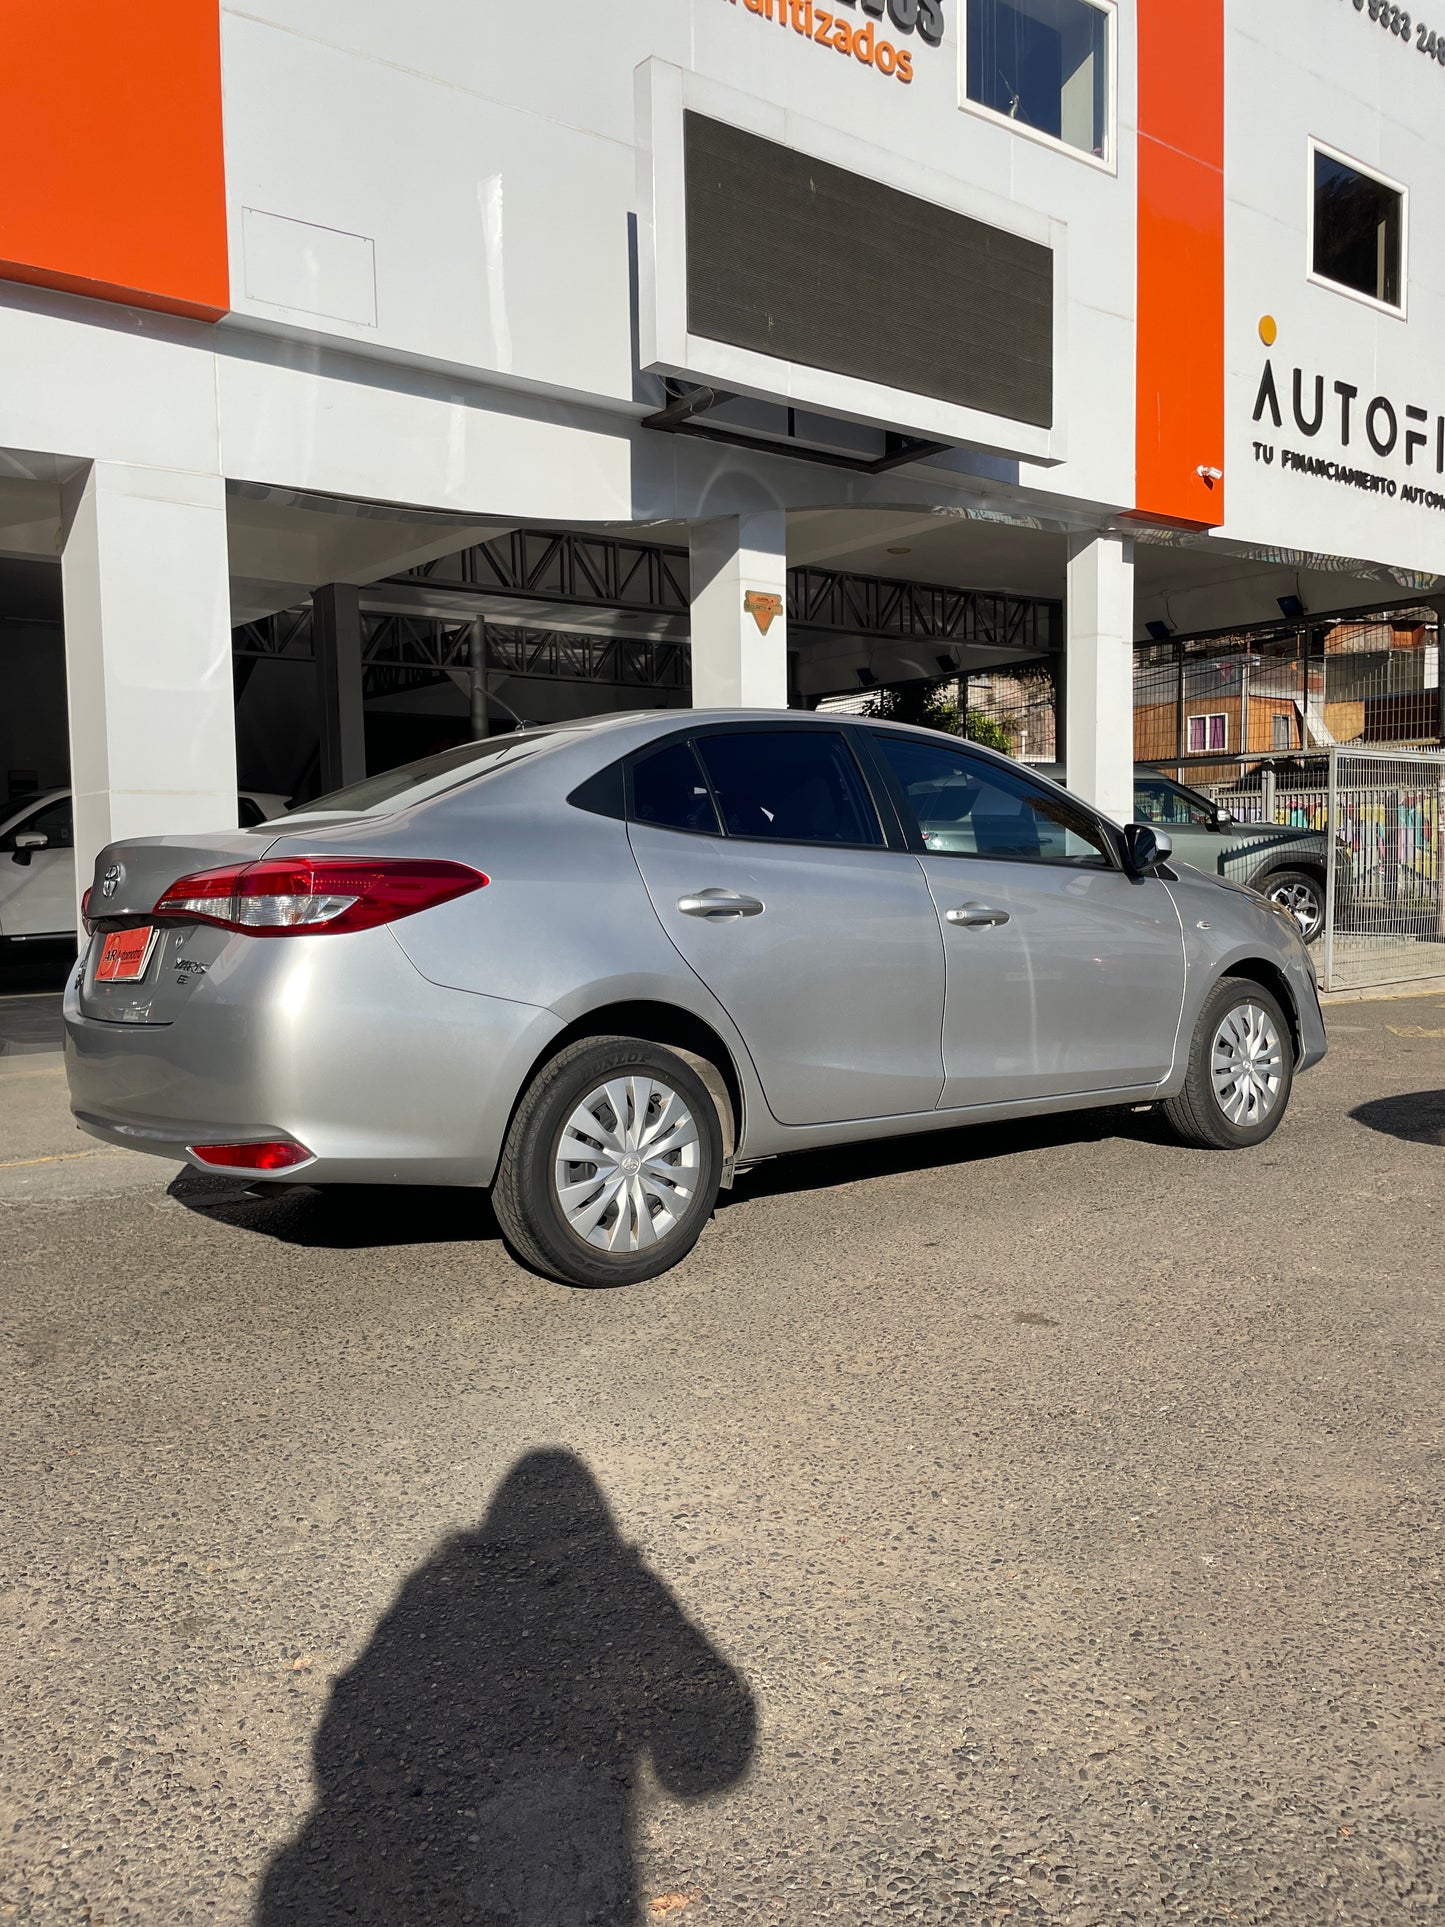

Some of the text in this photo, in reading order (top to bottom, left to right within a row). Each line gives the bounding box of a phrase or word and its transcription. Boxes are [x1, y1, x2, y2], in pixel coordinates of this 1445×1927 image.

[1252, 441, 1274, 465] TU
[1400, 484, 1445, 511] AUTOM
[106, 949, 118, 961] AR
[174, 958, 209, 974] YARIS
[176, 974, 191, 985] E
[582, 1052, 652, 1081] DUNLOP
